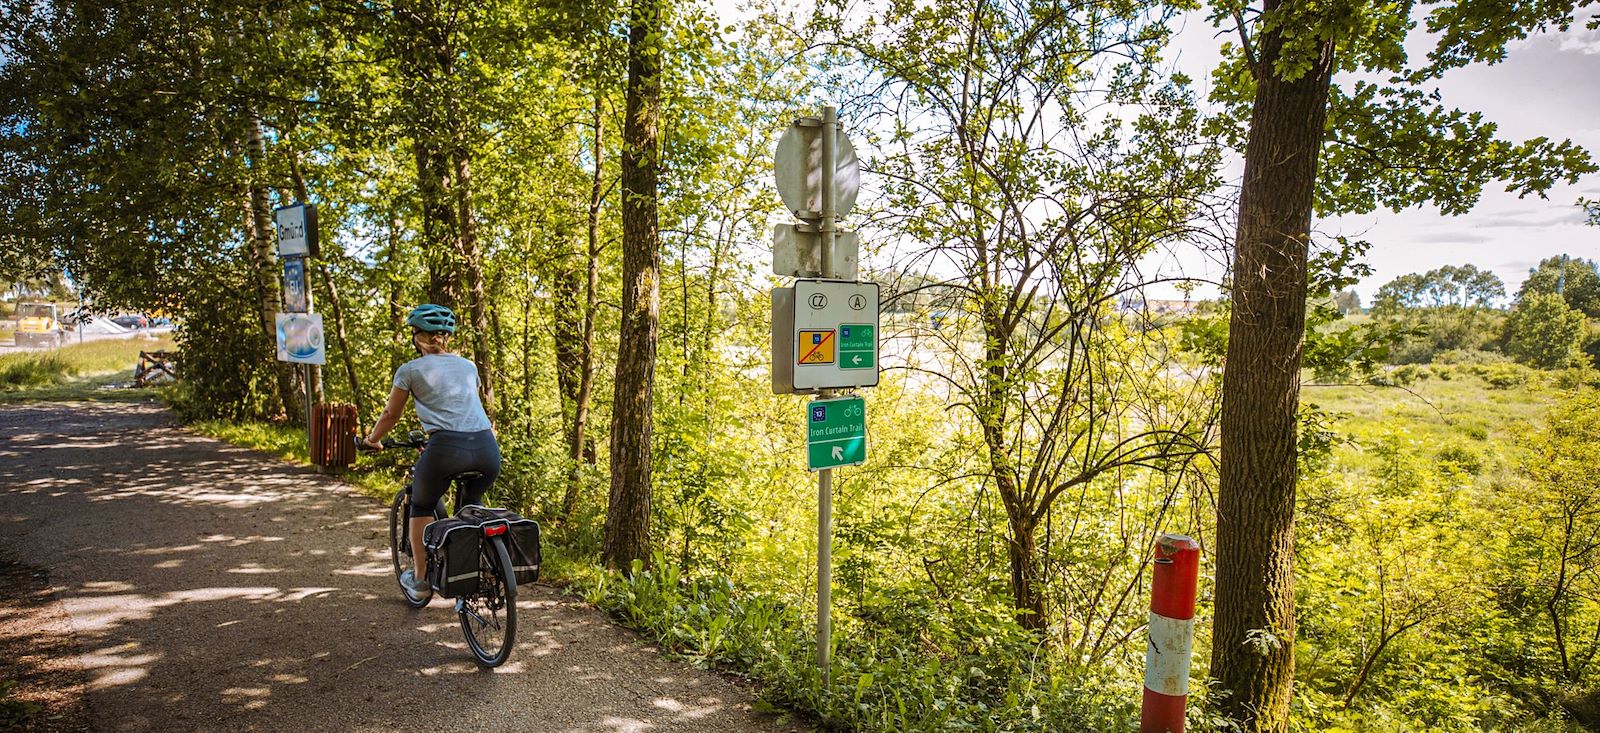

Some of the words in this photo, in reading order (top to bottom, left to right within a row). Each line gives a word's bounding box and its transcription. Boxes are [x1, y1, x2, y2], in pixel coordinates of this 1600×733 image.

[279, 221, 303, 240] Gmünd
[812, 295, 824, 307] CZ
[854, 296, 861, 308] A
[810, 428, 824, 437] Iron
[825, 424, 848, 436] Curtain
[849, 422, 863, 433] Trail
